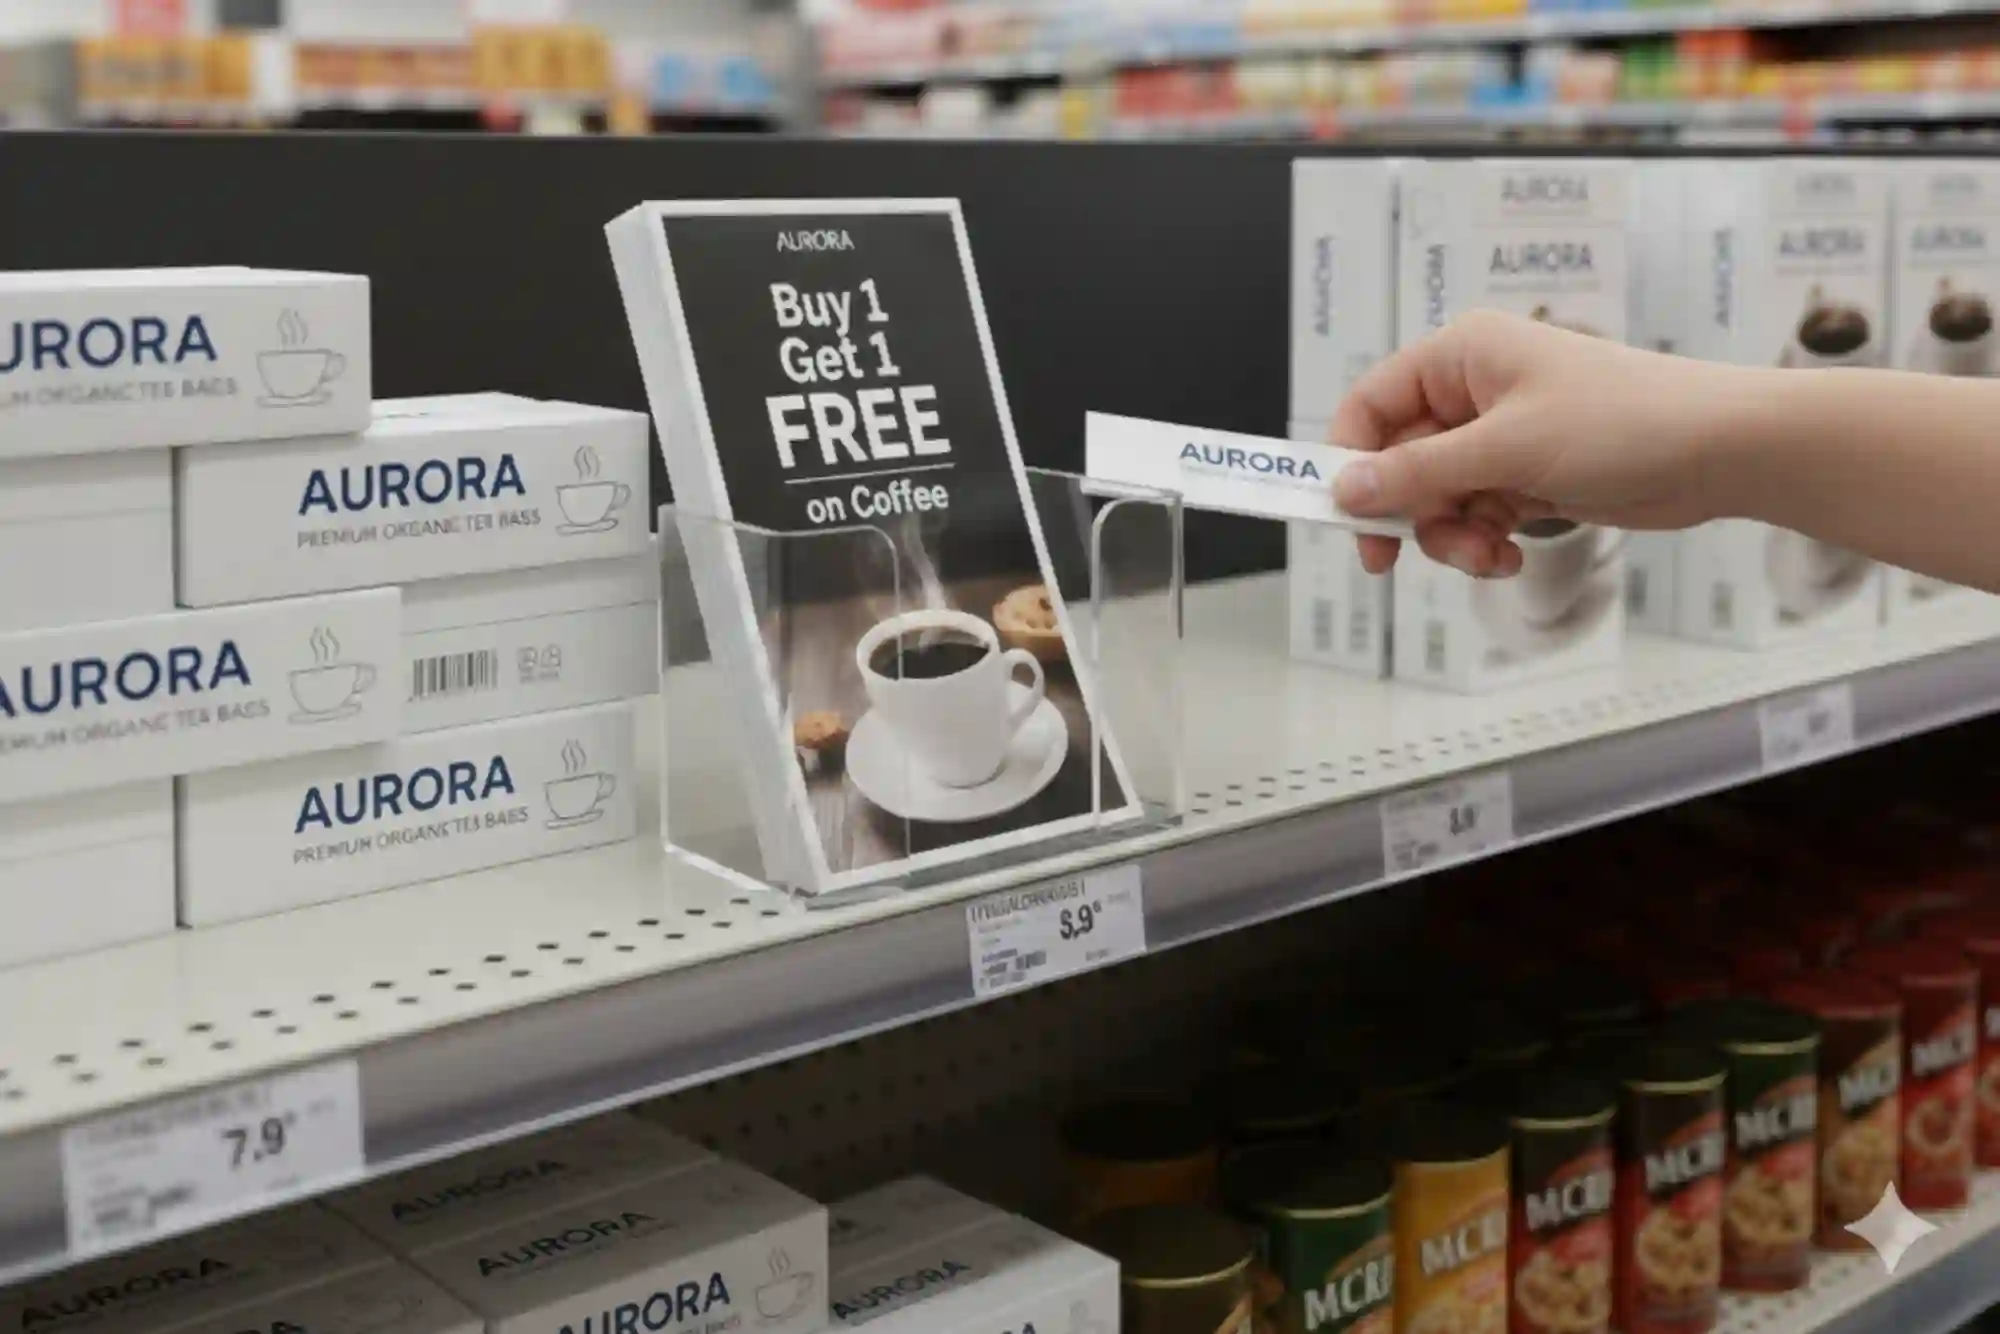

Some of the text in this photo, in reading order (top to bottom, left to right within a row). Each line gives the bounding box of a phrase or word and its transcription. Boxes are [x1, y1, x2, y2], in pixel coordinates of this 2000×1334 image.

[776, 229, 855, 252] AURORA
[769, 278, 889, 337] Buy 1
[0, 314, 218, 374] URORA
[779, 331, 900, 383] Get 1
[765, 384, 952, 468] FREE
[297, 453, 527, 517] AURORA
[1179, 442, 1321, 481] AURORA
[806, 478, 950, 523] on Coffee
[294, 755, 515, 834] AURORA
[391, 1159, 567, 1222] AURORA
[478, 1210, 655, 1276] AURORA
[21, 1258, 231, 1330] AURORA
